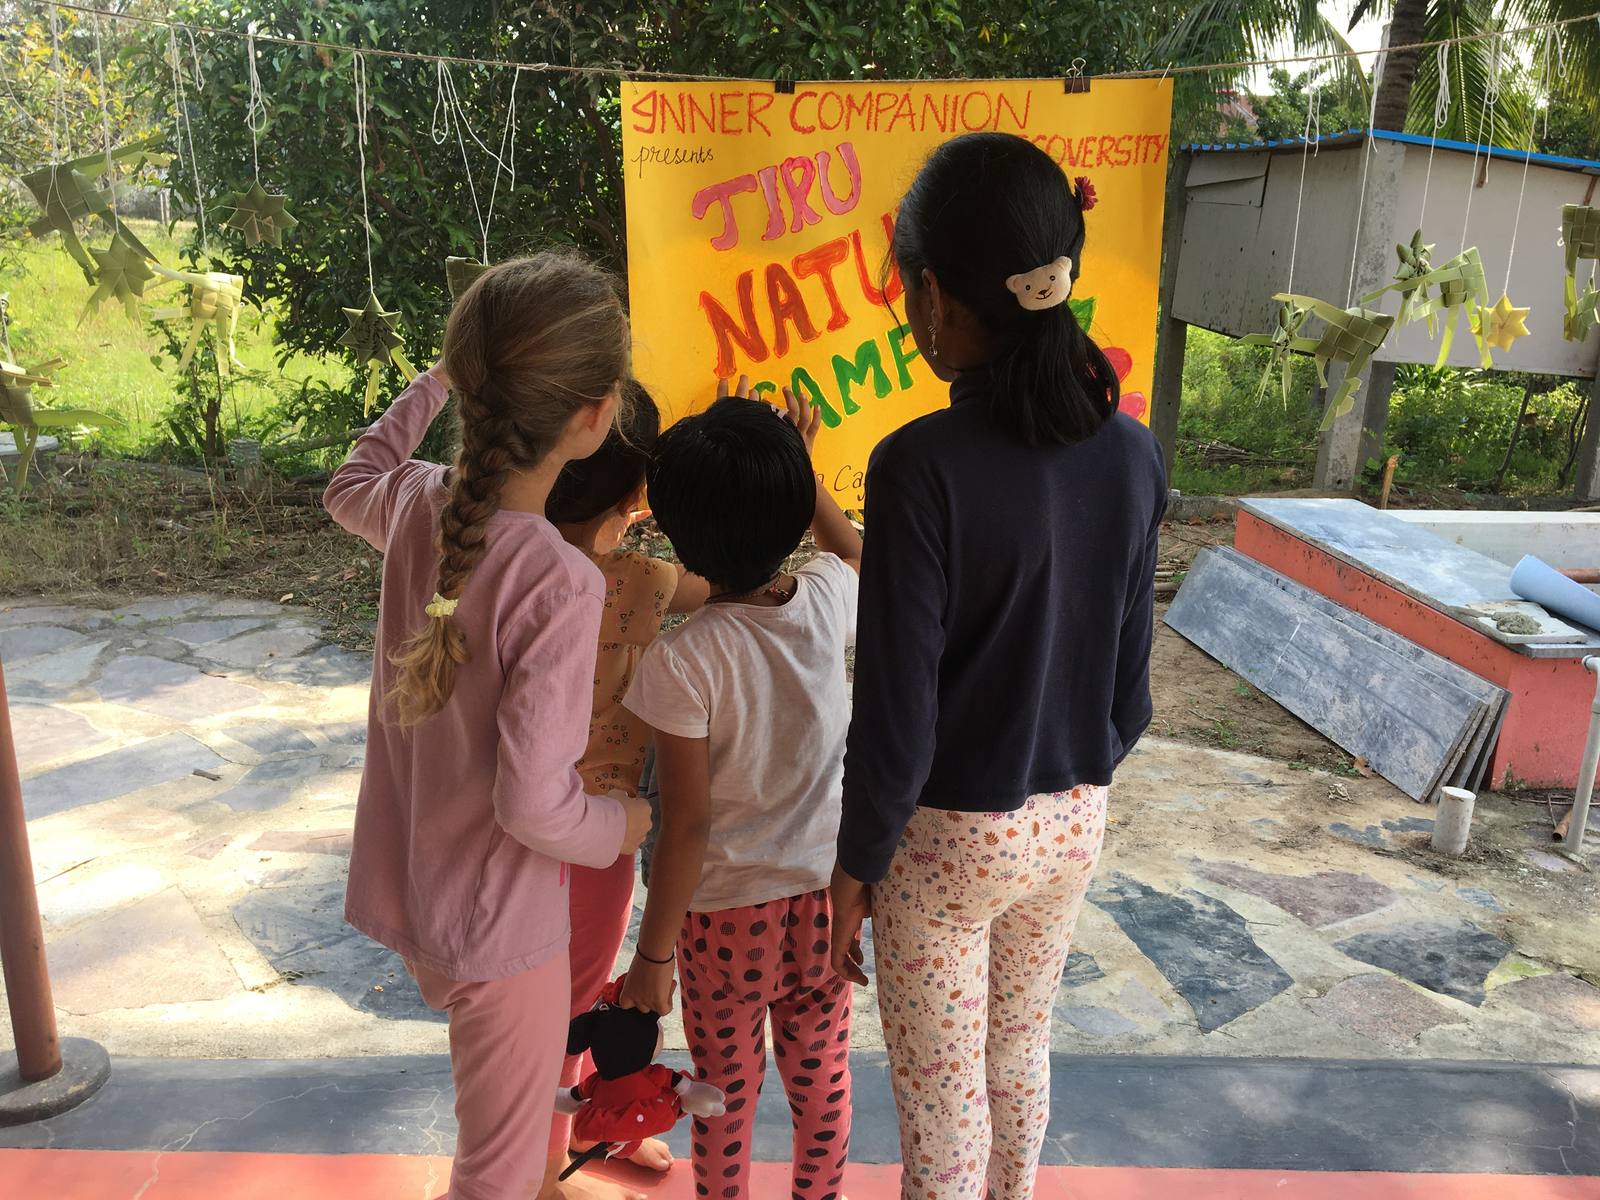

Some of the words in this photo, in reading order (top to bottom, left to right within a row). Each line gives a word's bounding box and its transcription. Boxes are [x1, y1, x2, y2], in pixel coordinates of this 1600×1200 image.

[789, 90, 1031, 134] COMPANION
[631, 146, 714, 179] presents
[699, 207, 904, 379] NATU
